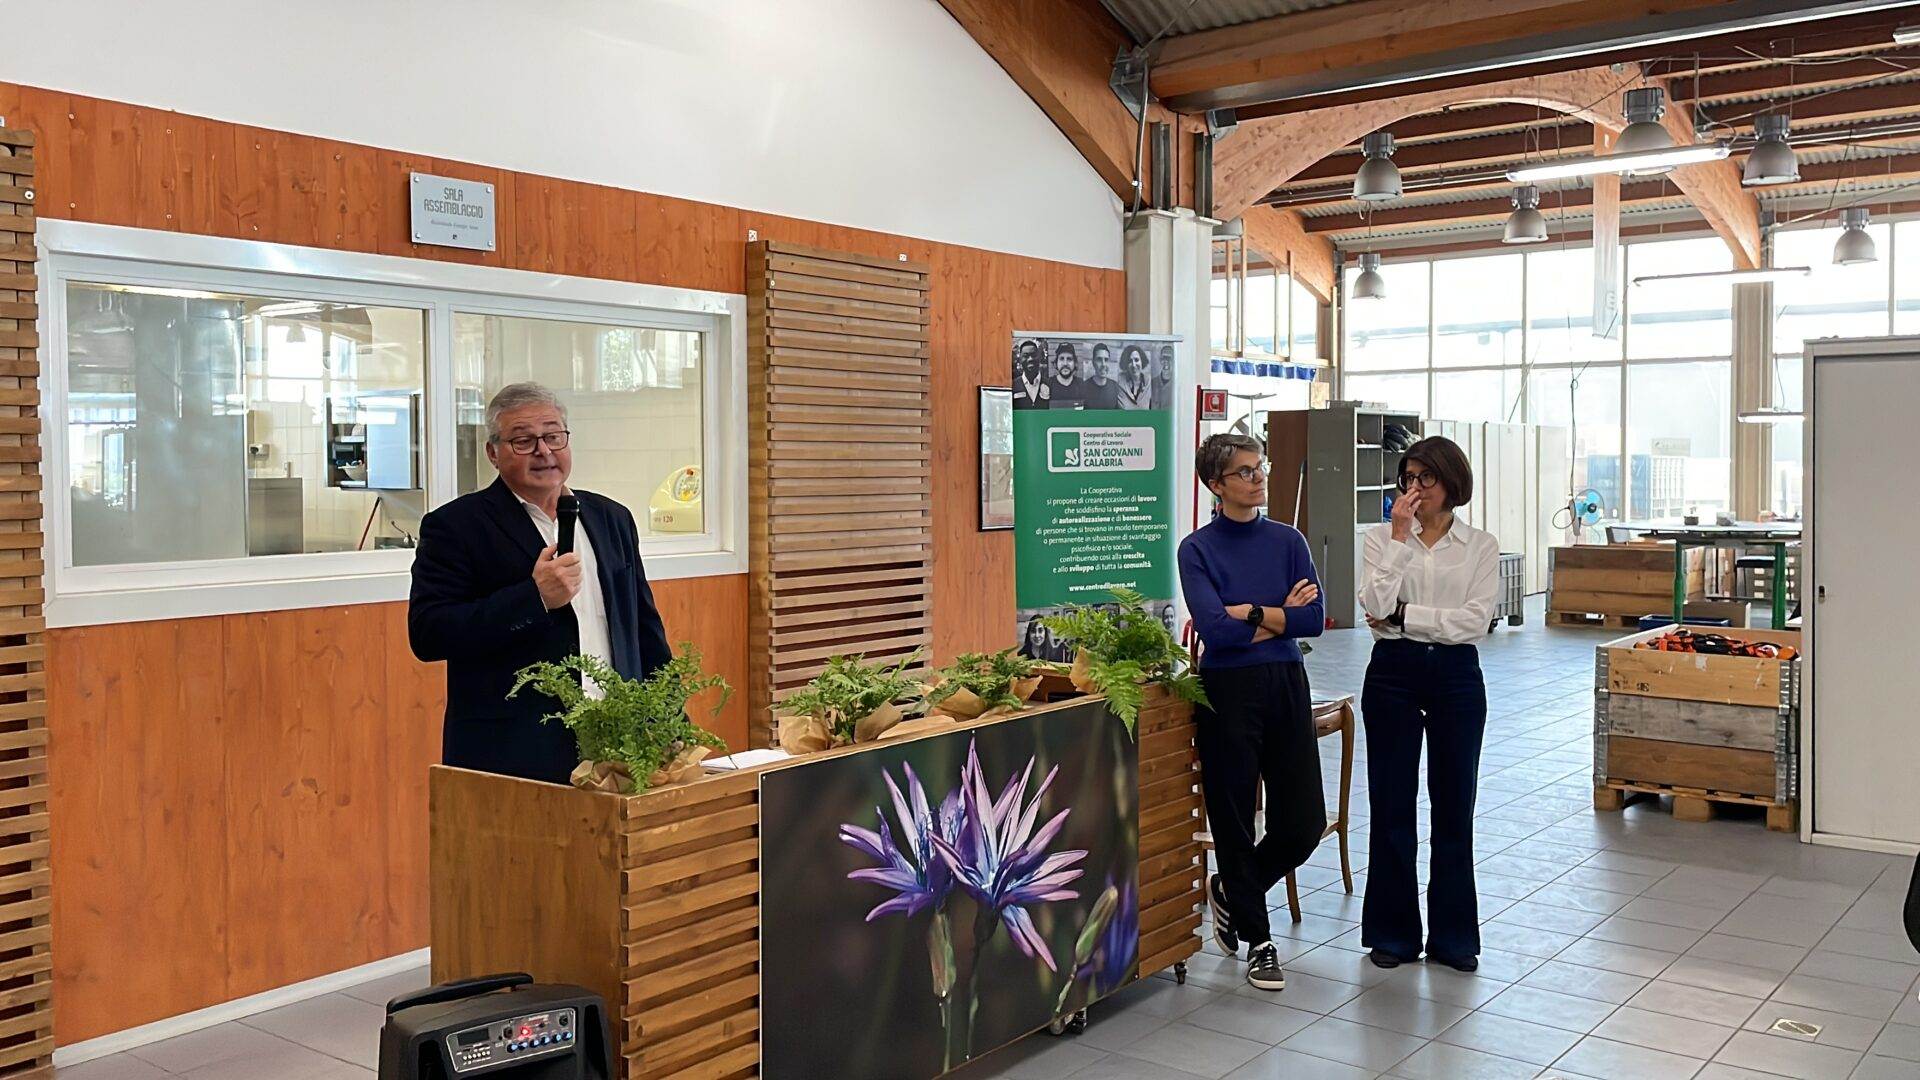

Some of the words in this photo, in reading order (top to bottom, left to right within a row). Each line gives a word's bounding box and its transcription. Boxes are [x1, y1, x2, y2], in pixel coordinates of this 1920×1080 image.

[443, 187, 464, 202] SALA
[423, 198, 484, 219] ASSEMBLAGGIO
[1084, 448, 1100, 457] SAN
[1102, 447, 1143, 457] GIOVANNI
[1084, 458, 1124, 467] CALABRIA
[1088, 487, 1122, 495] Cooperativa
[1052, 498, 1077, 507] propone
[1104, 495, 1130, 503] occasioni
[1137, 494, 1157, 502] lavoro
[1058, 515, 1110, 524] autorealizzazione
[1122, 514, 1152, 522] benessere
[1043, 528, 1066, 536] persone
[1132, 523, 1168, 532] temporaneo
[1048, 536, 1084, 545] permanente
[1128, 533, 1161, 542] svantaggio
[1071, 545, 1101, 554] psicofisico
[1060, 555, 1099, 563] contribuendo
[1111, 552, 1122, 560] alla
[1123, 551, 1145, 559] crescita
[1057, 565, 1068, 573] allo
[1069, 564, 1094, 573] sviluppo
[1095, 563, 1101, 571] di
[1102, 562, 1116, 570] tutta
[1068, 581, 1136, 592] www.centrodilavoro.net
